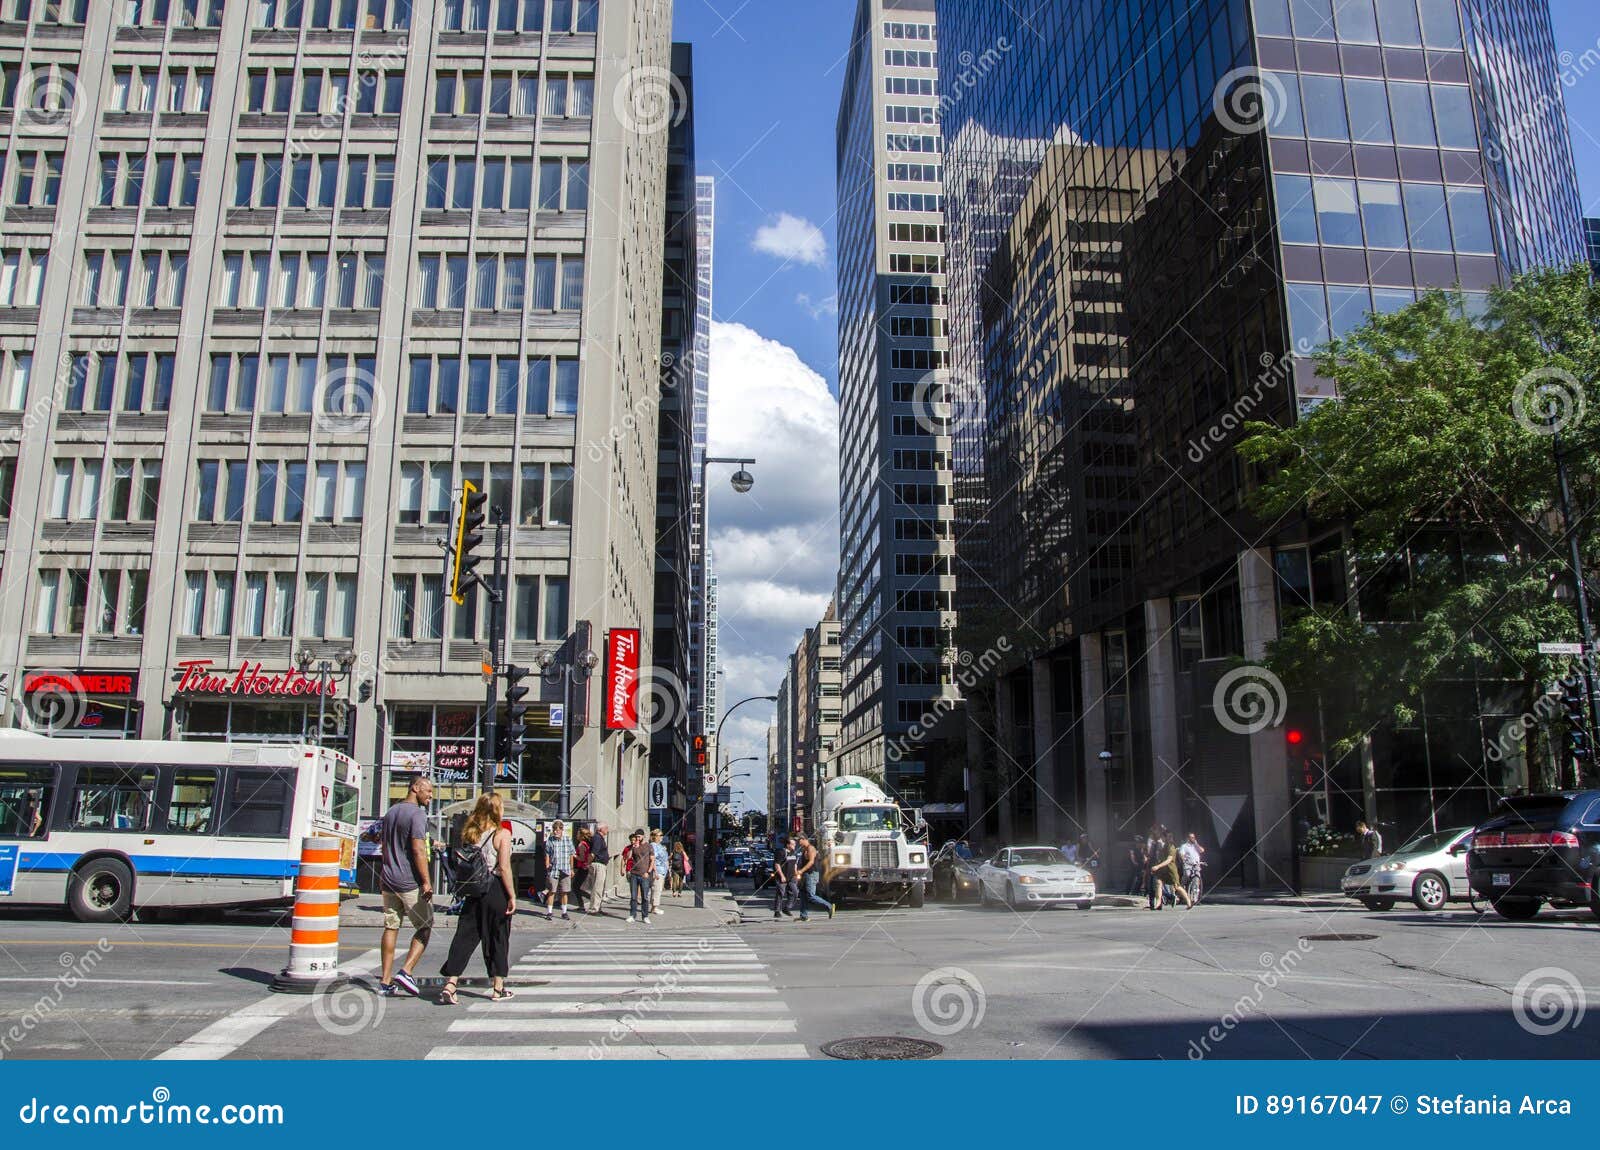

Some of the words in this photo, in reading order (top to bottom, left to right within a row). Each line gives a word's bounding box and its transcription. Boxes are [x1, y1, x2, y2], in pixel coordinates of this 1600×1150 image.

[616, 633, 634, 662] Tim
[177, 659, 226, 693] Tim
[230, 659, 338, 696] Hortons
[612, 663, 634, 722] Hortons
[436, 745, 459, 755] JOUR
[461, 745, 474, 755] DES
[440, 758, 469, 766] CAMPS
